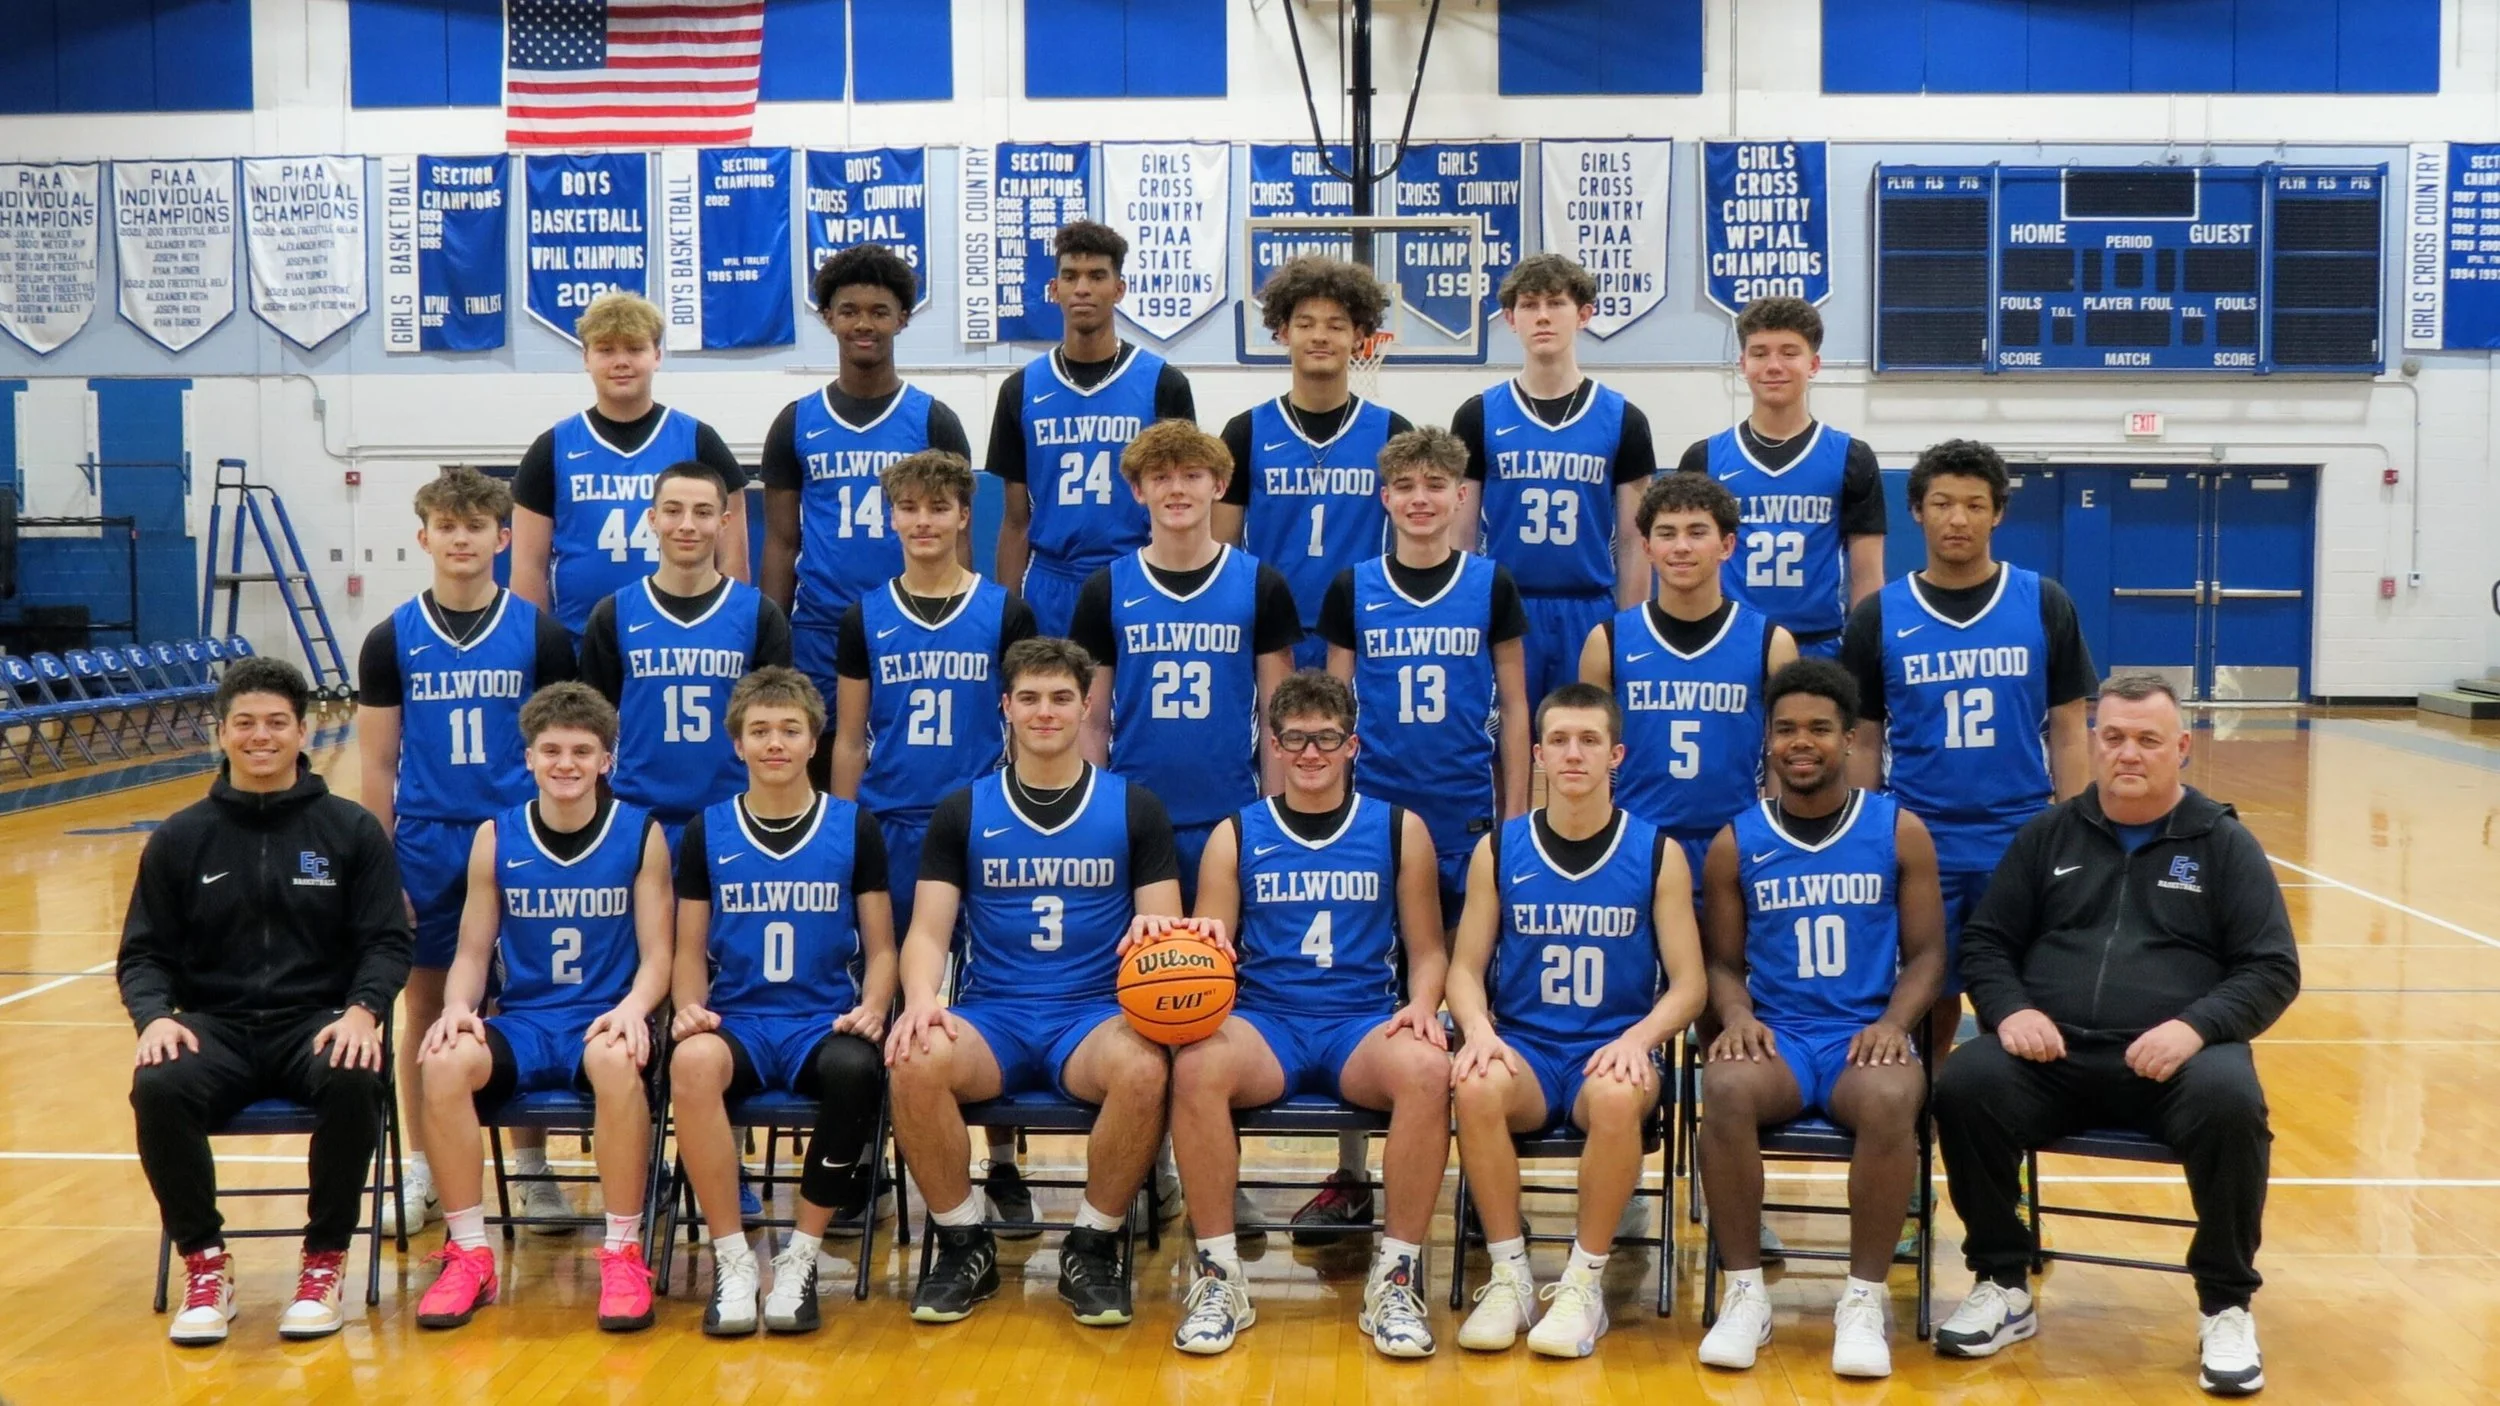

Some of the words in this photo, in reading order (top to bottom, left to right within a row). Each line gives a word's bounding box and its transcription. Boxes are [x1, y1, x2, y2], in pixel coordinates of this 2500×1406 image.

[722, 157, 767, 173] SECTION
[845, 156, 881, 183] BOYS
[1011, 152, 1073, 172] SECTION
[1142, 154, 1190, 174] GIRLS
[1438, 151, 1478, 175] GIRLS
[1581, 152, 1631, 173] GIRLS
[1738, 145, 1794, 170] GIRLS
[2471, 155, 2500, 169] SECT
[19, 171, 63, 189] PIAA
[151, 168, 196, 186] PIAA
[282, 163, 324, 181] PIAA
[432, 166, 493, 185] SECTION
[562, 170, 610, 196] BOYS
[714, 174, 774, 190] CHAMPIONS
[966, 146, 988, 222] COUNTRY
[1736, 171, 1798, 196] CROSS
[1887, 176, 1914, 190] PLYR
[1925, 176, 1944, 190] FLS
[1959, 176, 1979, 190] PTS
[2279, 176, 2306, 189] PLYR
[2317, 176, 2336, 189] FLS
[2351, 176, 2371, 189] PTS
[2464, 172, 2500, 185] CHAMP
[0, 191, 94, 208] DIVIDUAL
[120, 187, 229, 206] INDIVIDUAL
[251, 183, 358, 202] INDIVIDUAL
[422, 189, 501, 210] CHAMPIONS
[807, 187, 847, 213] CROSS
[864, 184, 923, 211] COUNTRY
[1000, 178, 1083, 197] CHAMPIONS
[1139, 178, 1192, 198] CROSS
[1251, 182, 1293, 206] CROSS
[1311, 181, 1353, 206] COUNT
[1397, 182, 1440, 206] CROSS
[1457, 180, 1519, 205] COUNTRY
[1579, 177, 1632, 197] CROSS
[2415, 152, 2440, 226] COUNTRY
[253, 202, 358, 222] CHAMPIONS
[705, 195, 730, 207] 2022
[997, 198, 1023, 210] 2002
[1029, 198, 1056, 210] 2005
[1128, 202, 1203, 222] COUNTRY
[1567, 201, 1643, 221] COUNTRY
[1723, 198, 1810, 223] COUNTRY
[0, 210, 93, 227] HAMPIONS
[120, 206, 230, 225] CHAMPIONS
[389, 164, 411, 274] BASKETBALL
[531, 208, 642, 233] BASKETBALL
[669, 174, 693, 278] BASKETBALL
[997, 211, 1023, 224] 2003
[1029, 211, 1056, 224] 2006
[825, 215, 905, 243] WPIAL
[997, 225, 1024, 238] 2004
[1139, 226, 1191, 245] PIAA
[1579, 225, 1632, 245] PIAA
[1726, 225, 1808, 249] WPIAL
[2011, 224, 2066, 243] HOME
[2189, 224, 2253, 243] GUEST
[1001, 239, 1027, 257] WPIAL
[1260, 242, 1353, 266] CHAMPION
[2106, 235, 2152, 249] PERIOD
[532, 247, 570, 270] WPIAL
[574, 246, 644, 270] CHAMPIONS
[966, 232, 989, 287] CROSS
[997, 258, 1024, 271] 2002
[1139, 250, 1192, 270] STATE
[1578, 249, 1632, 269] STATE
[1713, 251, 1821, 276] CHAMPIONS
[2413, 232, 2438, 286] CROSS
[997, 272, 1025, 284] 2004
[1734, 277, 1804, 302] 2000
[424, 295, 450, 314] WPIAL
[465, 294, 502, 315] FINALIST
[671, 284, 694, 325] BOYS
[1003, 286, 1021, 303] PIAA
[2000, 296, 2042, 310] FOULS
[2083, 297, 2132, 310] PLAYER
[2140, 296, 2174, 310] FOUL
[2215, 296, 2257, 310] FOULS
[391, 294, 413, 344] GIRLS
[967, 296, 989, 339] BOYS
[1138, 298, 1191, 317] 1992
[2412, 291, 2435, 339] GIRLS
[2000, 352, 2042, 365] SCORE
[2105, 352, 2150, 365] MATCH
[2214, 352, 2256, 366] SCORE
[1033, 415, 1141, 446] ELLWOOD
[2132, 413, 2156, 432] EXIT
[1058, 450, 1112, 506] 24
[1497, 450, 1606, 486] ELLWOOD
[570, 473, 660, 502] ELLWO
[1264, 466, 1375, 496] ELLWOOD
[1734, 495, 1832, 524] LLWOOD
[2081, 489, 2095, 508] E
[838, 485, 884, 538] 14
[1520, 488, 1579, 546] 33
[598, 508, 660, 562] 44
[1307, 504, 1324, 557] 1
[1746, 531, 1805, 587] 22
[1124, 622, 1240, 654] ELLWOOD
[1364, 626, 1480, 658] ELLWOOD
[629, 648, 744, 679] ELLWOOD
[879, 651, 989, 685] ELLWOOD
[1902, 646, 2029, 685] ELLWOOD
[410, 669, 523, 701] ELLWOOD
[1151, 660, 1212, 719] 23
[1397, 664, 1446, 723] 13
[1626, 680, 1748, 714] ELLWOOD
[663, 685, 712, 743] 15
[907, 688, 953, 746] 21
[1943, 687, 1995, 749] 12
[449, 707, 487, 765] 11
[1669, 720, 1700, 779] 5
[300, 851, 329, 880] EC
[983, 857, 1115, 888] ELLWOOD
[2168, 855, 2199, 884] EC
[720, 881, 839, 913] ELLWOOD
[1254, 870, 1379, 903] ELLWOOD
[1754, 873, 1882, 911] ELLWOOD
[505, 887, 628, 918] ELLWOOD
[1030, 895, 1064, 952] 3
[1513, 904, 1637, 938] ELLWOOD
[1300, 910, 1333, 968] 4
[1794, 914, 1846, 980] 10
[551, 927, 583, 985] 2
[763, 921, 794, 983] 0
[1136, 949, 1215, 975] Wilson
[1541, 944, 1604, 1009] 20
[1156, 992, 1202, 1010] EVO
